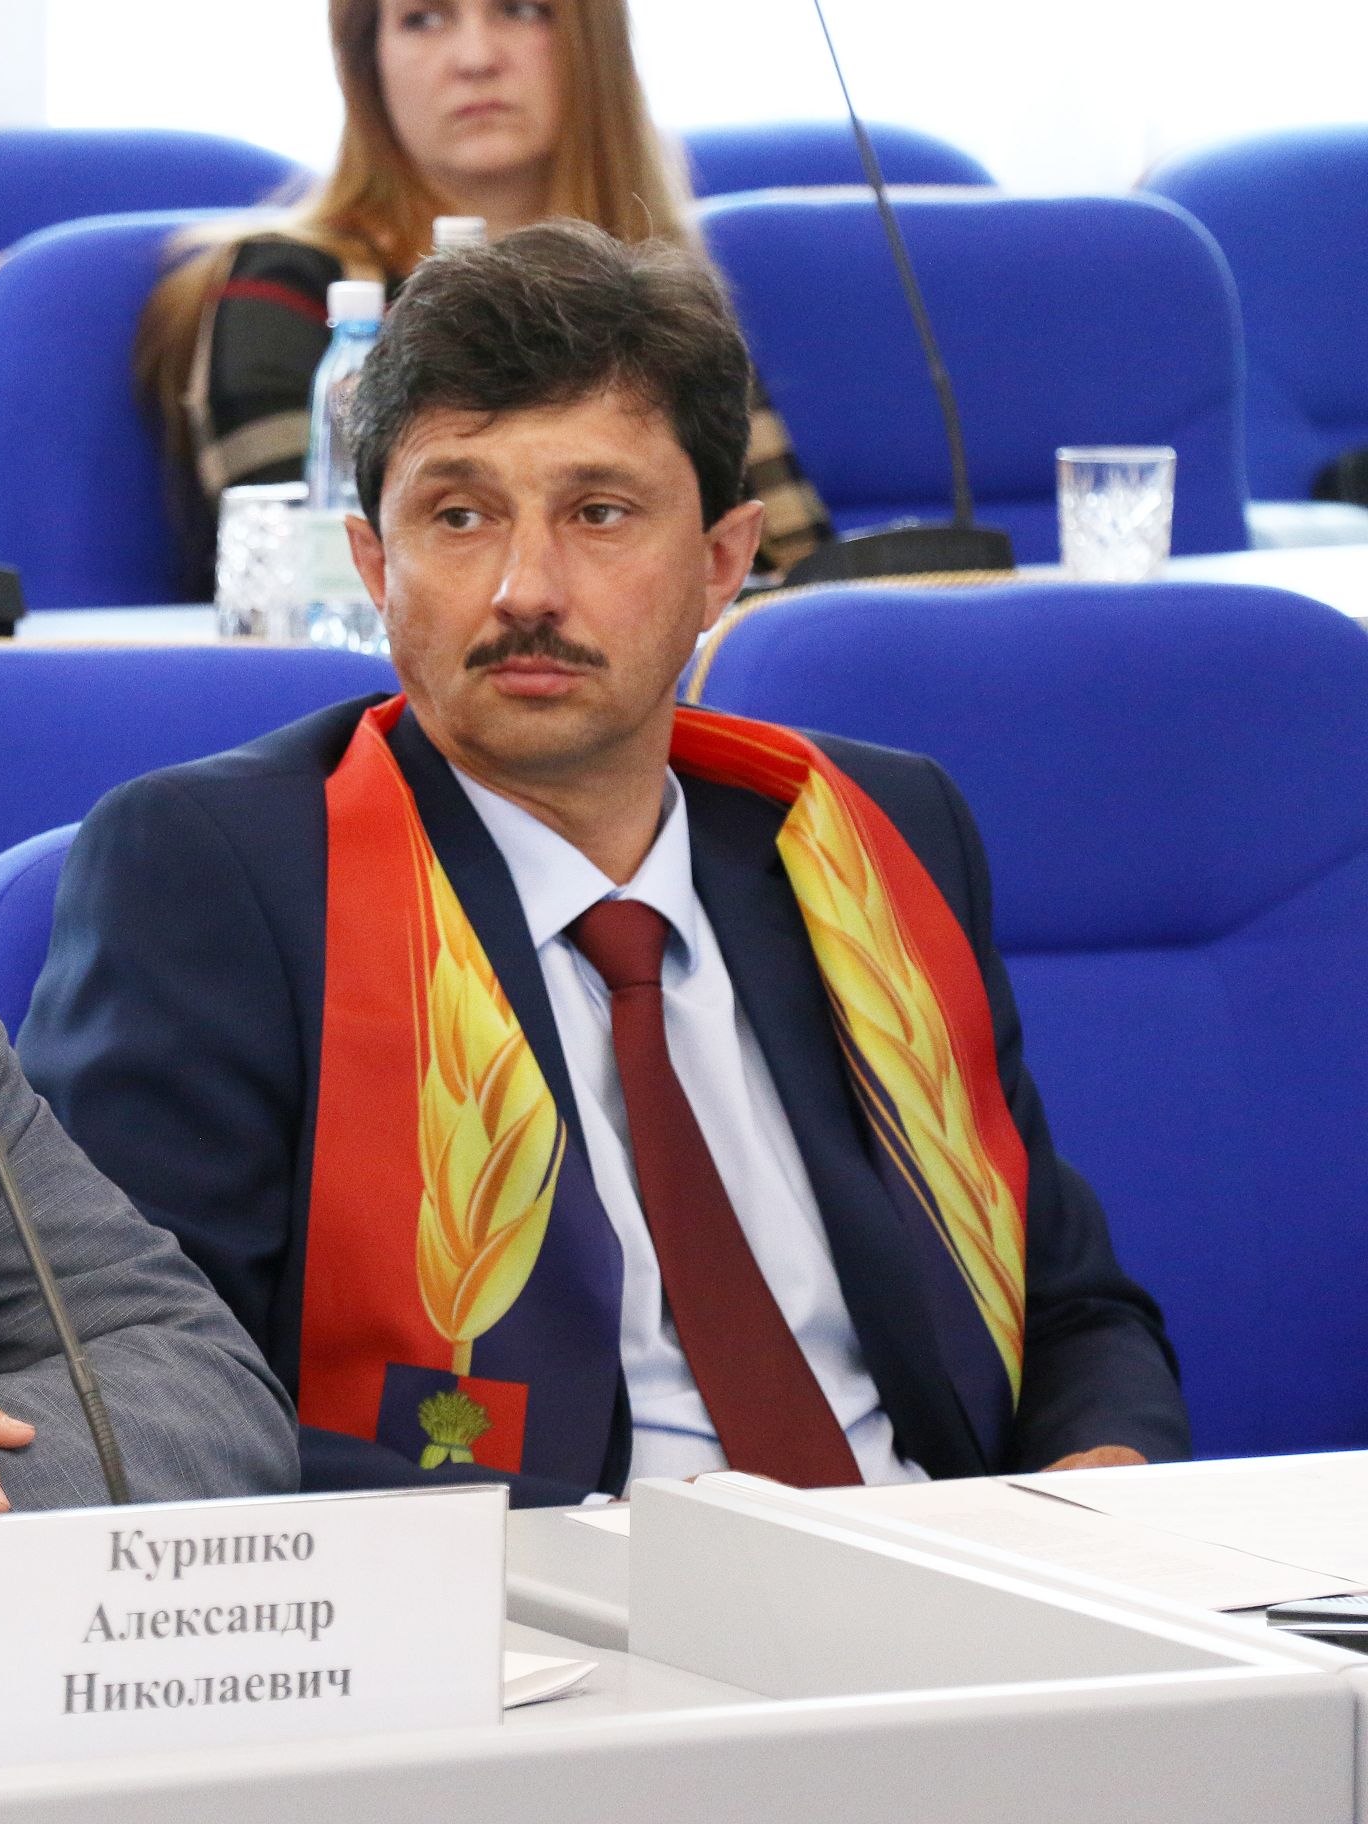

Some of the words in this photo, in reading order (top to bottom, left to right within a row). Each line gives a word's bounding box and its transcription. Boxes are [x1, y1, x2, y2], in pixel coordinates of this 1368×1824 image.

[107, 1529, 315, 1581] Курипко
[83, 1598, 336, 1643] Александр
[61, 1667, 353, 1715] Николаевич
